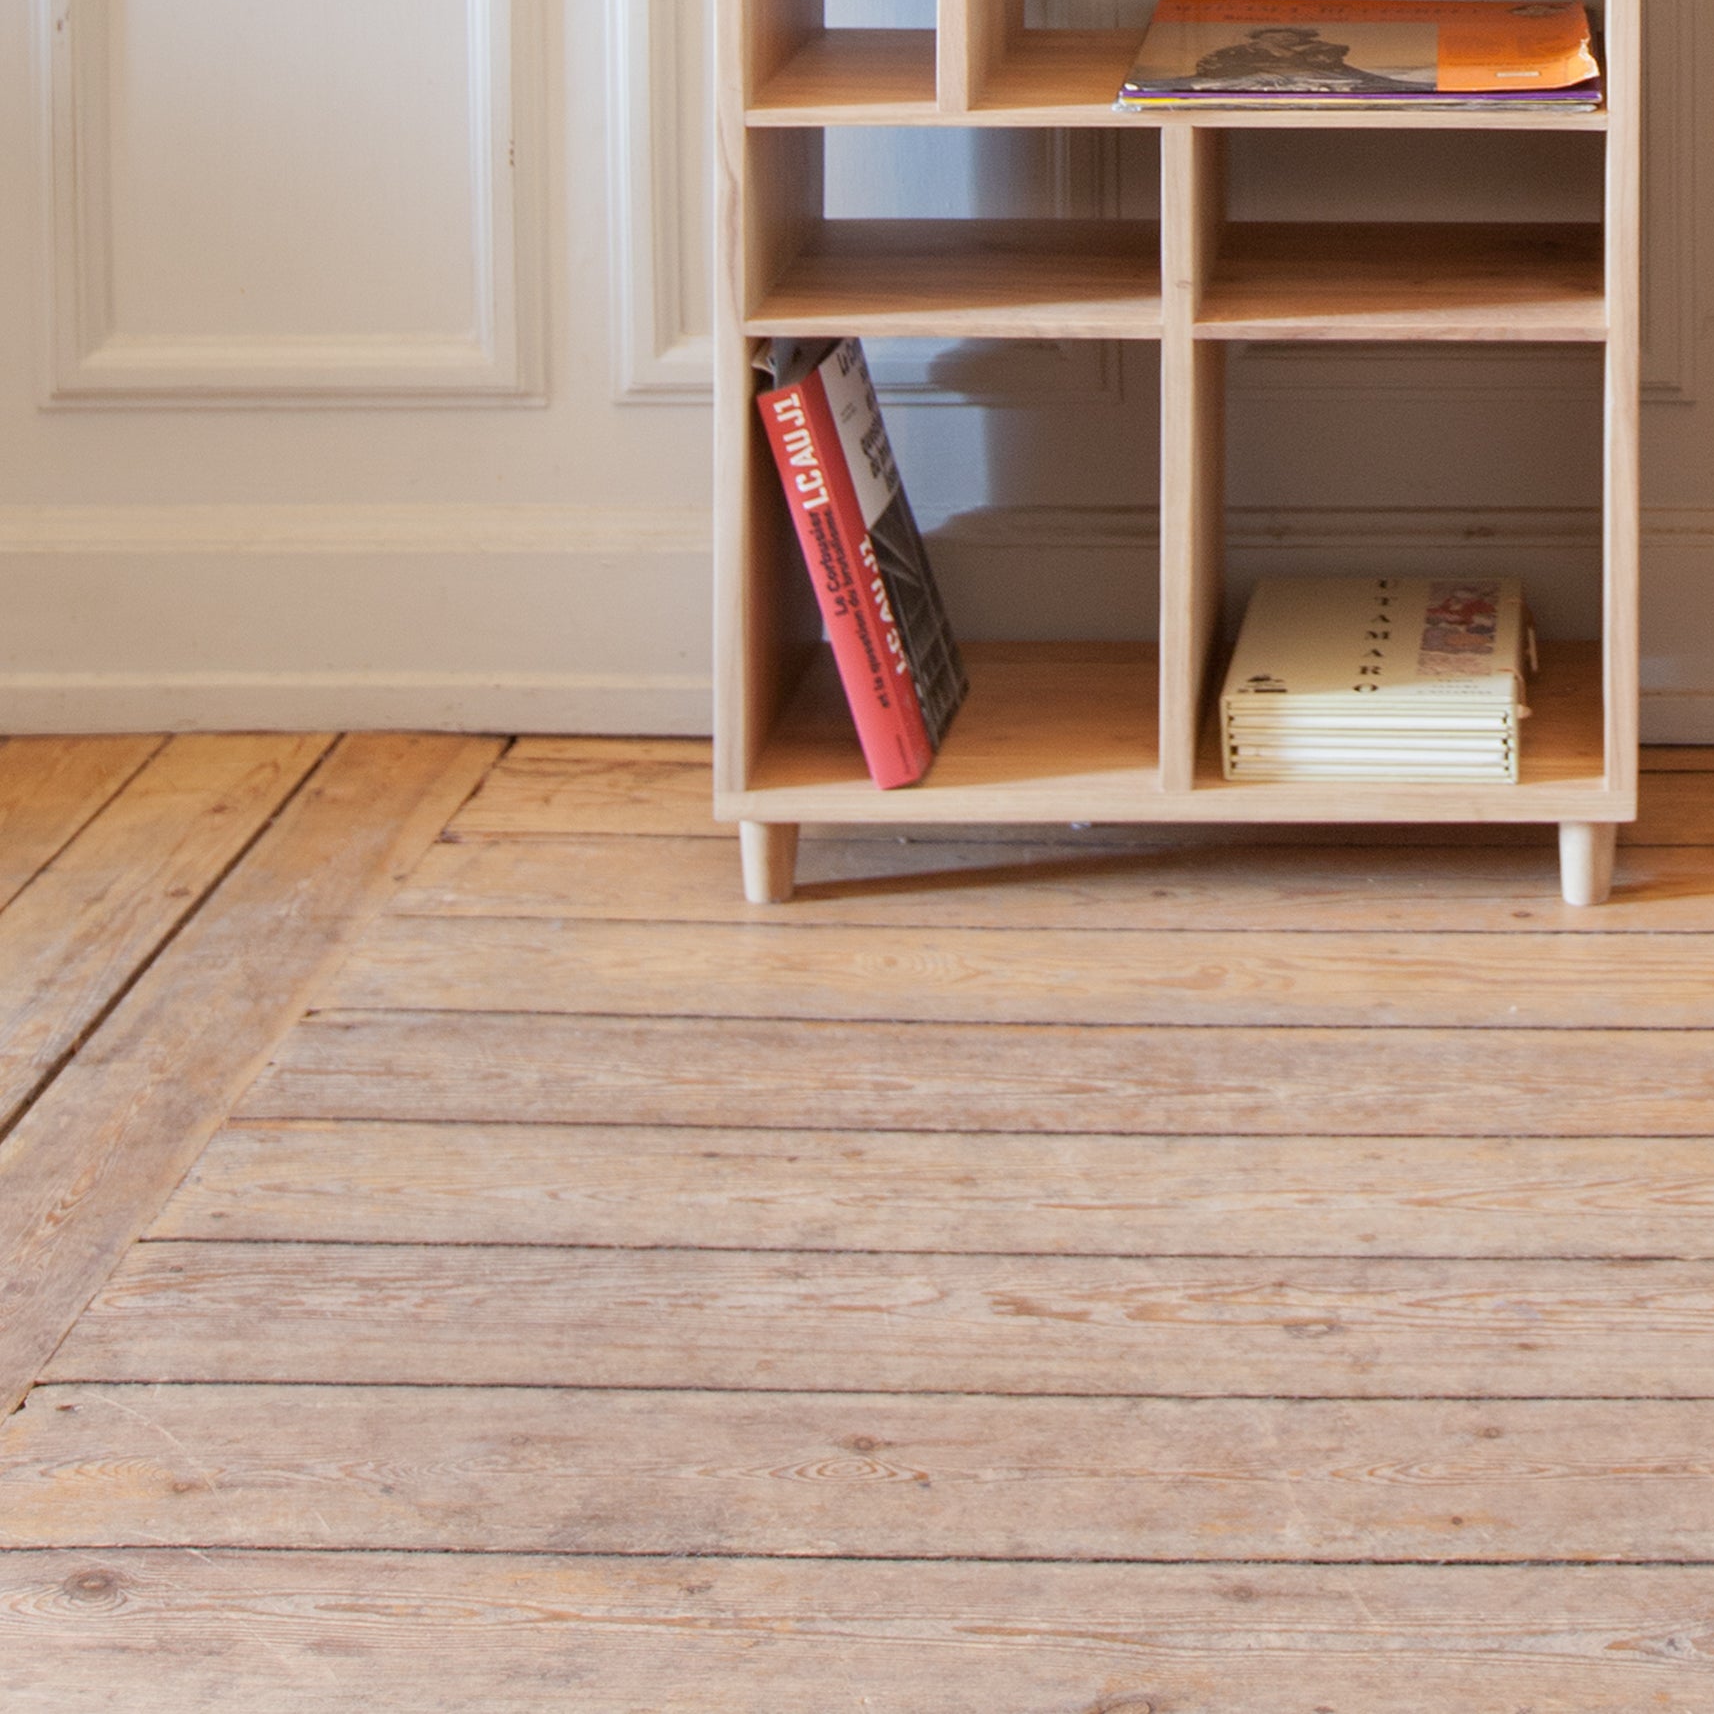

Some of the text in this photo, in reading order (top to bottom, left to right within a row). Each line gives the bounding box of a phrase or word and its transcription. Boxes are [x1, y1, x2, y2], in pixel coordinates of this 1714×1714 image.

[773, 392, 830, 510] LC AU J1
